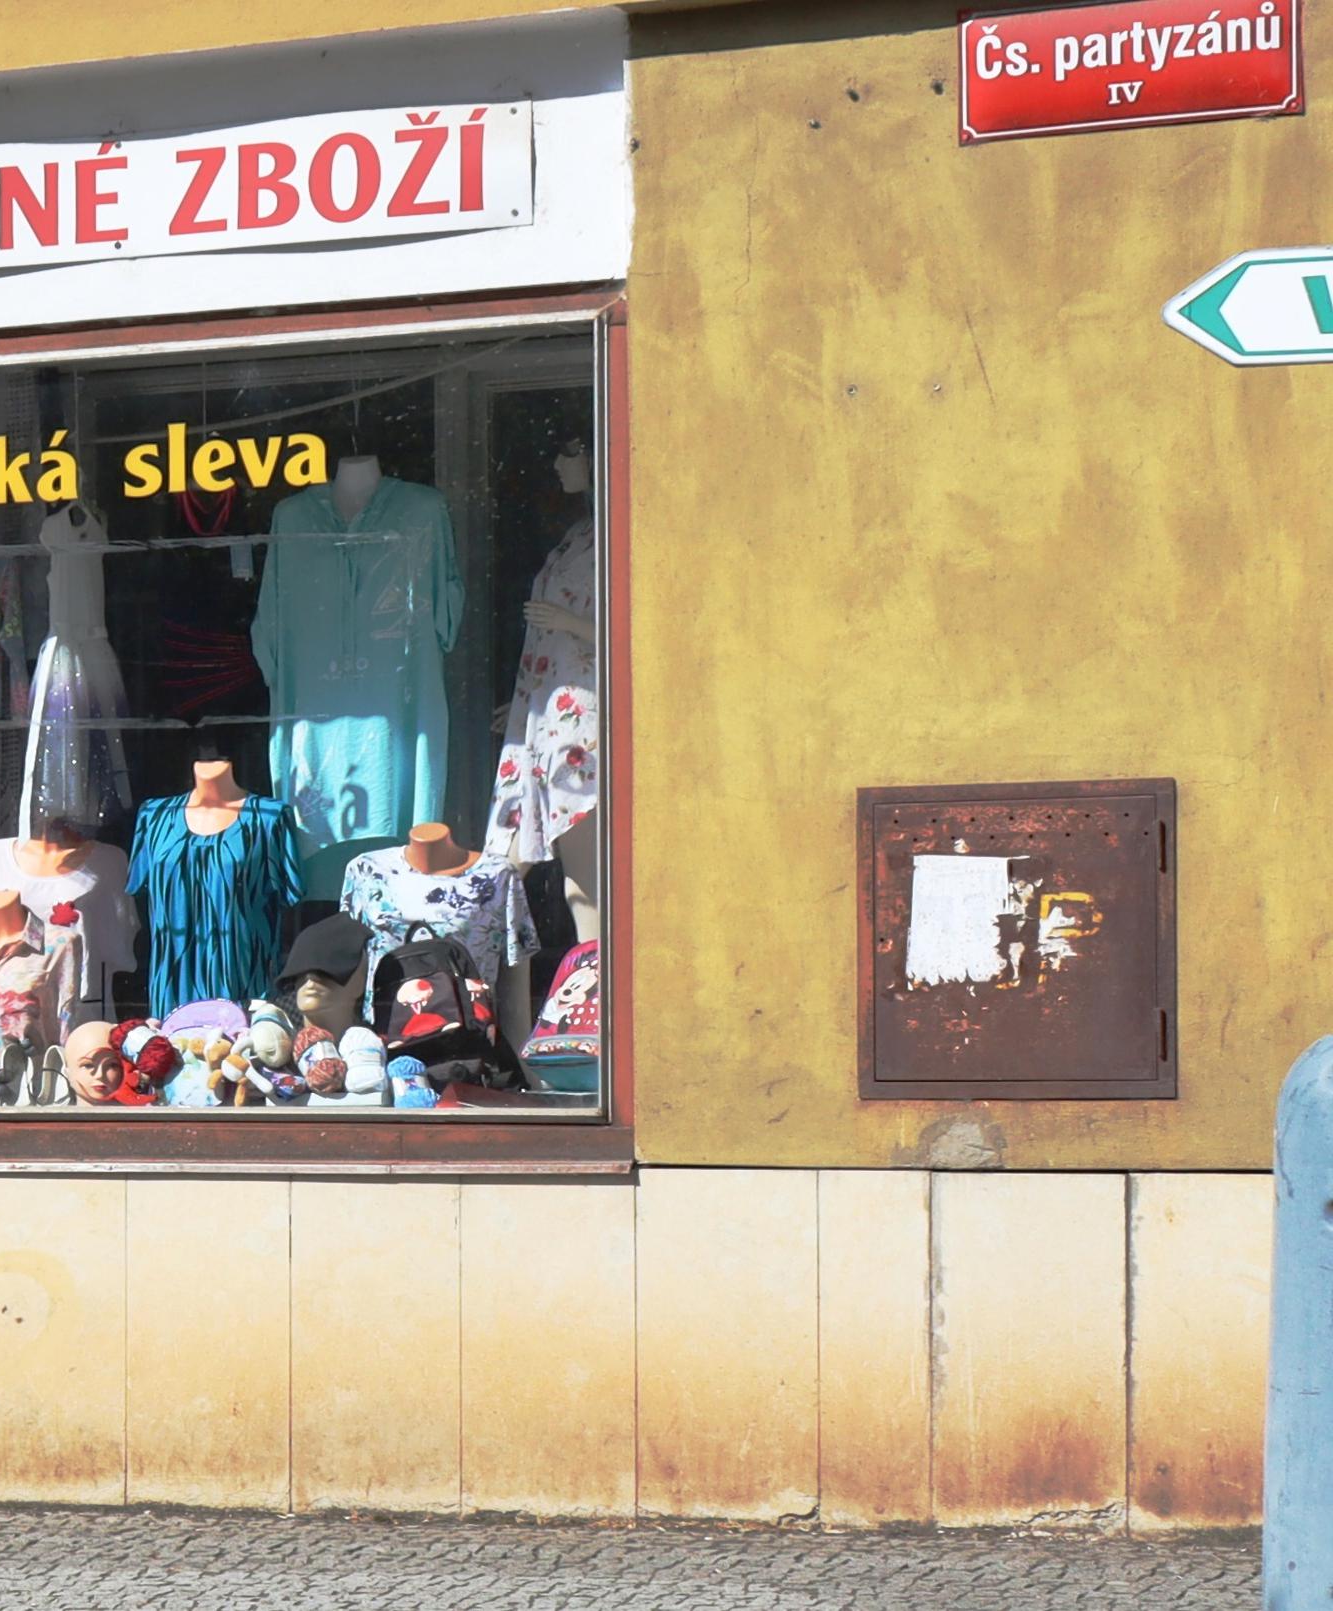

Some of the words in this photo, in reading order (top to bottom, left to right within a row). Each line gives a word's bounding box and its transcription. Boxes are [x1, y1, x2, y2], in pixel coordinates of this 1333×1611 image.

[976, 24, 1040, 80] Čs.
[1055, 1, 1281, 81] partyzánů
[1108, 81, 1143, 105] IV
[169, 107, 487, 236] ZBOŽÍ
[124, 423, 328, 497] sleva
